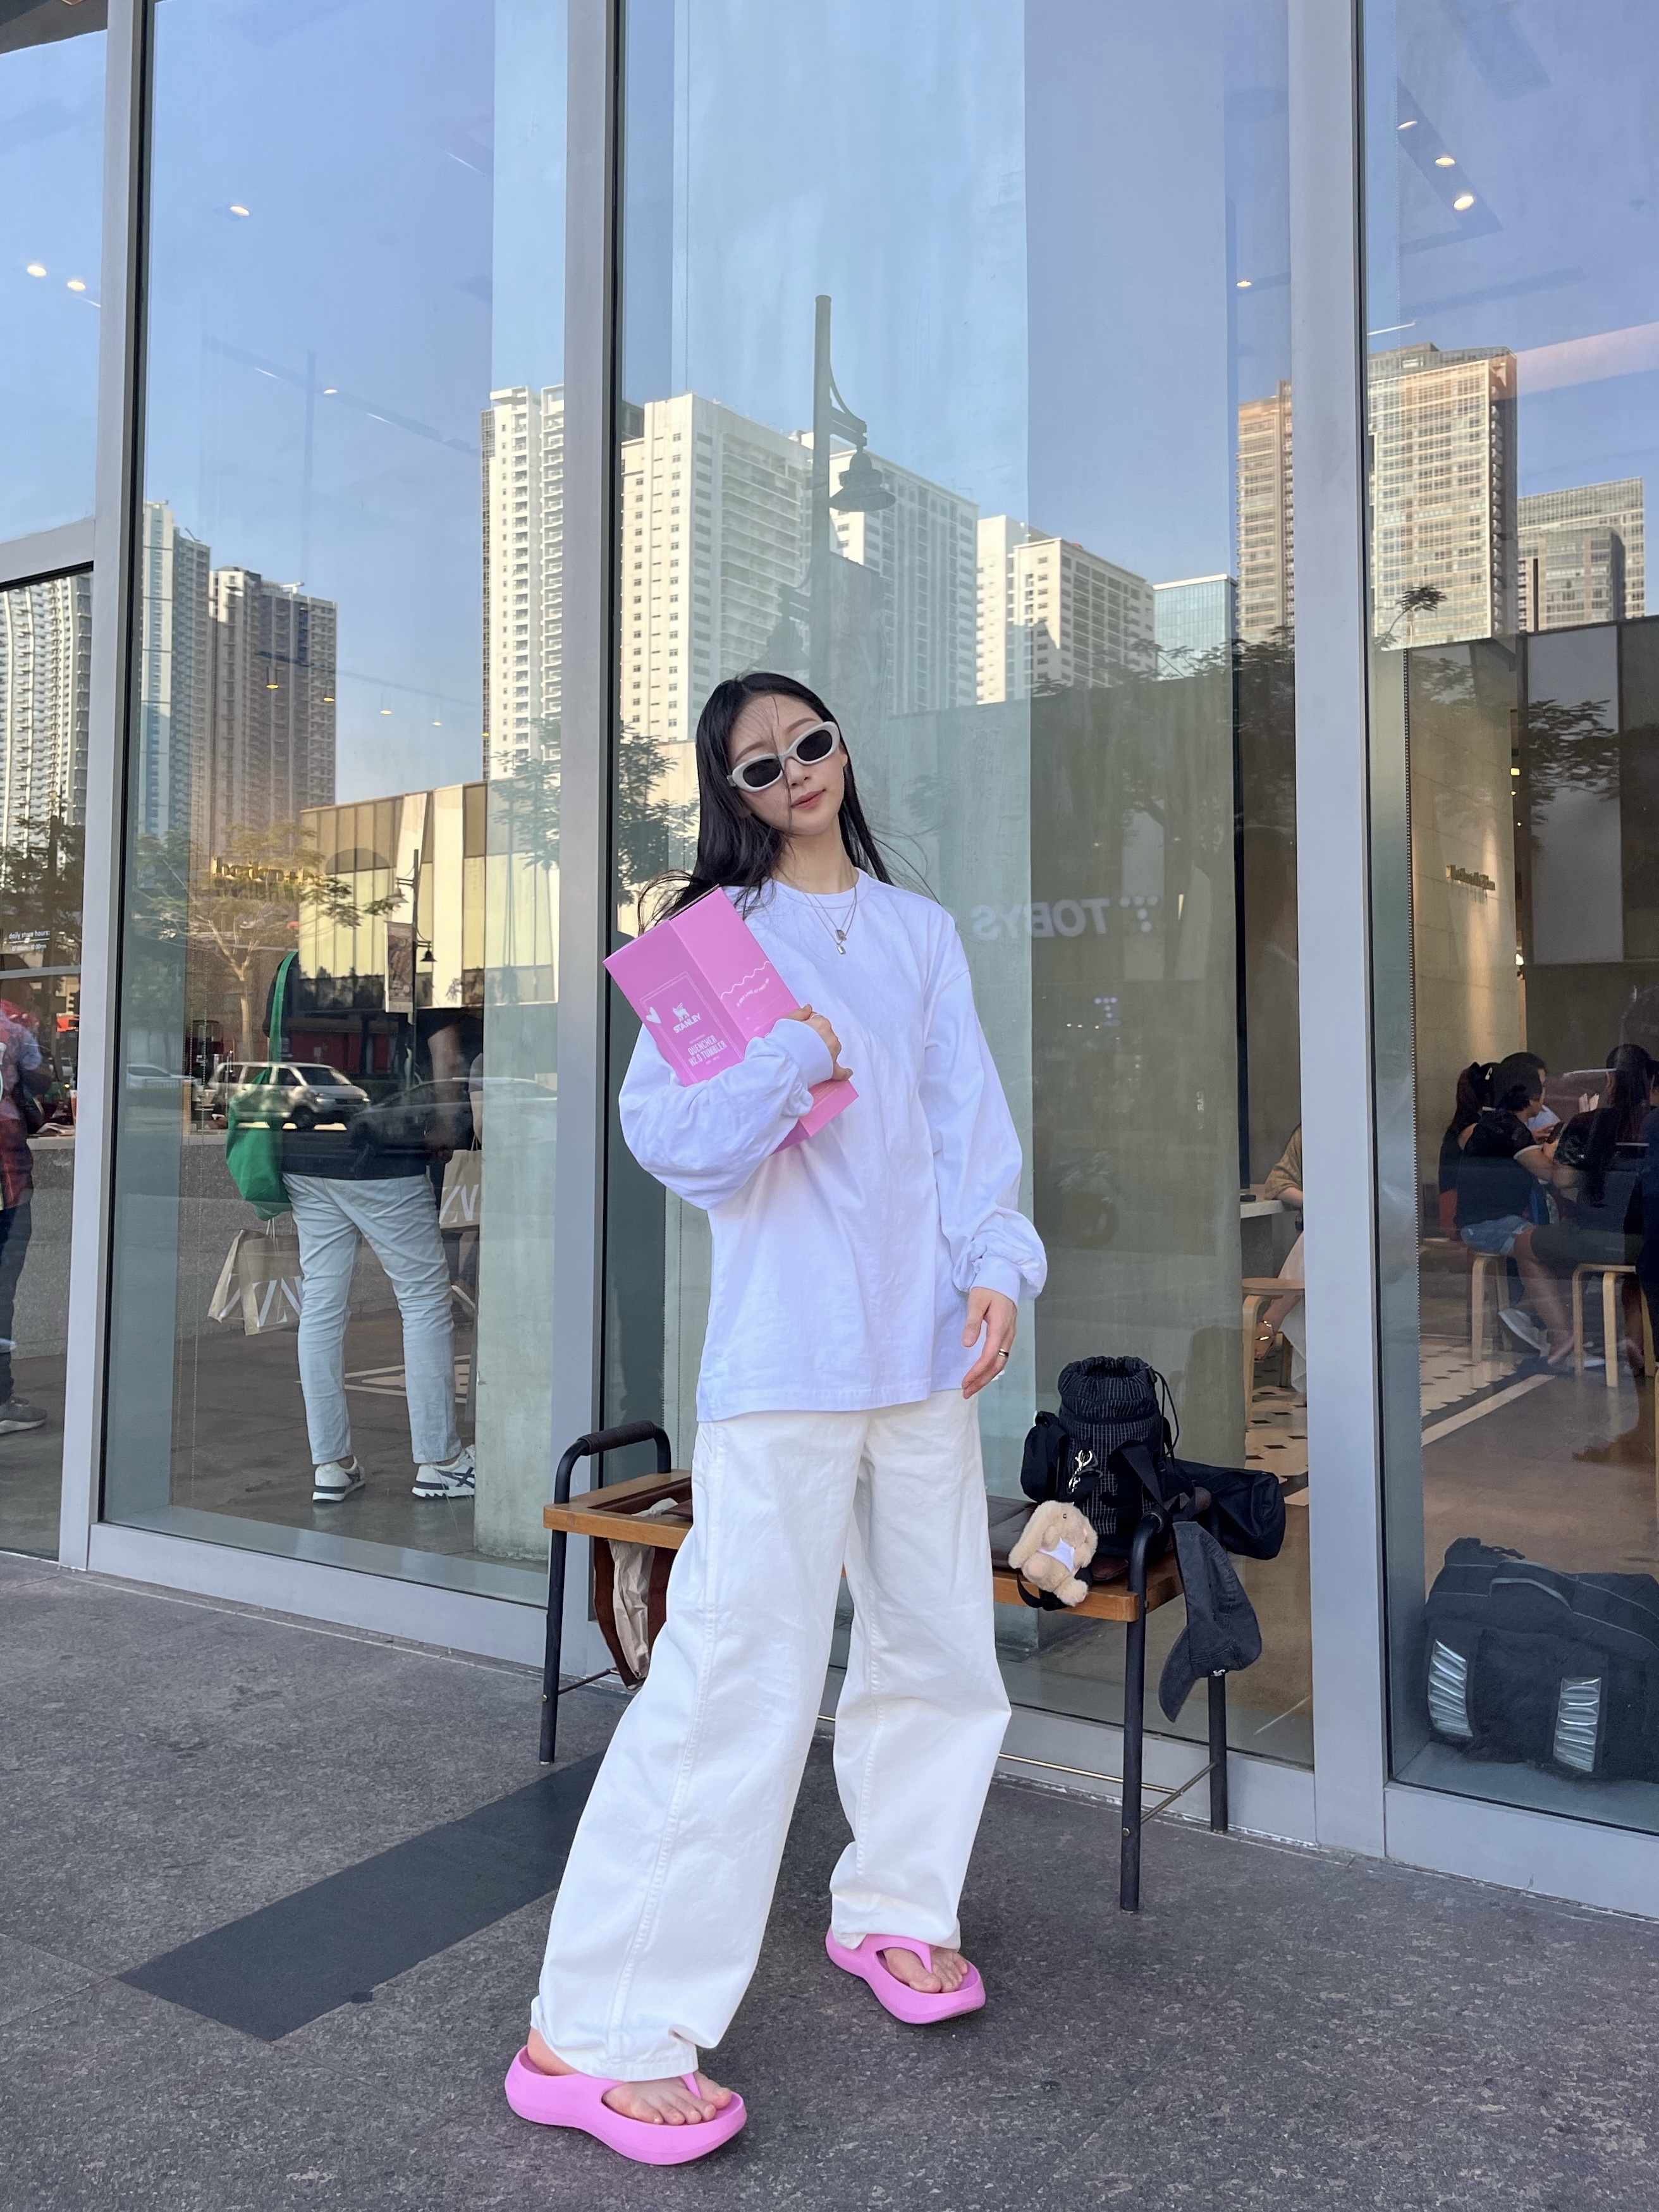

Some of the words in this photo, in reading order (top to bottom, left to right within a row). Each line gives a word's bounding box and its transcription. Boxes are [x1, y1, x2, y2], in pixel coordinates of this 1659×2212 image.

[673, 1012, 701, 1033] STANLEY
[687, 1035, 717, 1056] QUENCHER
[700, 1040, 728, 1059] TUMBLER
